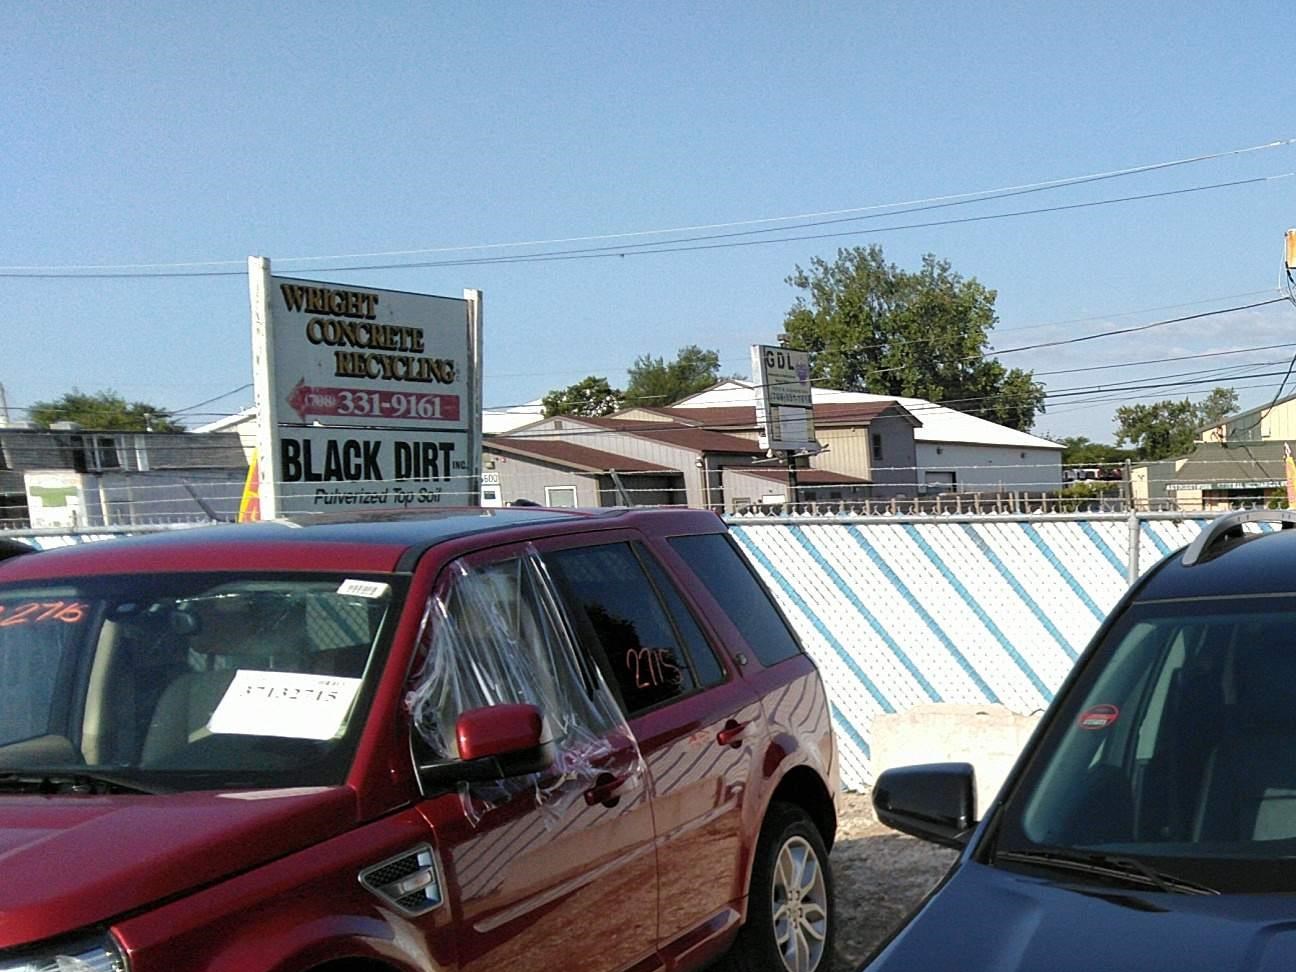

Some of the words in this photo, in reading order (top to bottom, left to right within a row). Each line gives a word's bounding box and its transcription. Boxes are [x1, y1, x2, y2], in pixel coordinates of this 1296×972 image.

[280, 283, 379, 320] WRIGHT
[306, 317, 425, 354] CONCRETE
[334, 350, 456, 385] RECYCLING
[766, 350, 794, 370] GDL
[336, 391, 444, 418] 331-9161
[280, 438, 384, 483] BLACK
[393, 441, 456, 483] DIRT
[314, 487, 389, 505] Pulverized
[392, 487, 415, 508] Top
[417, 487, 442, 504] Soil
[626, 648, 682, 689] 2715
